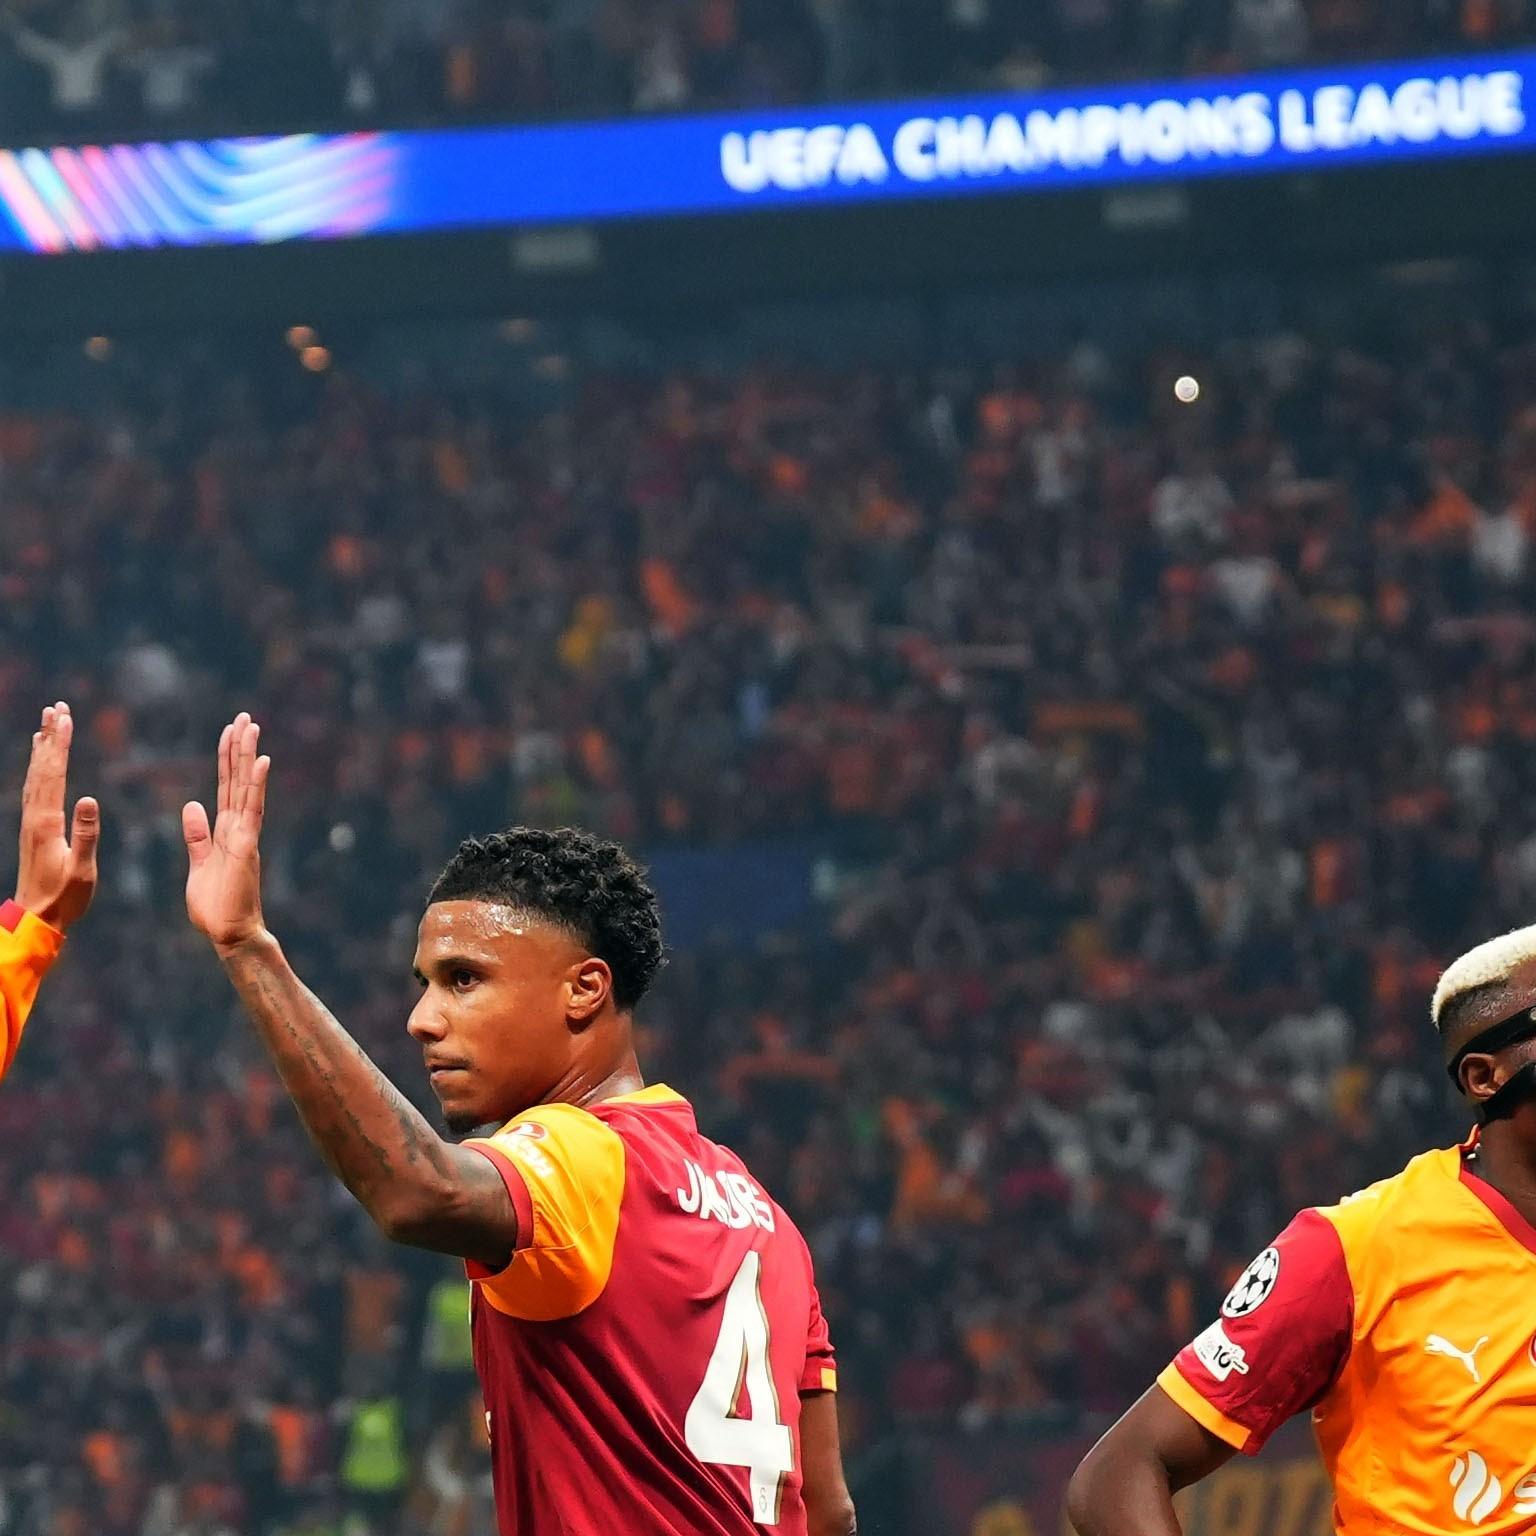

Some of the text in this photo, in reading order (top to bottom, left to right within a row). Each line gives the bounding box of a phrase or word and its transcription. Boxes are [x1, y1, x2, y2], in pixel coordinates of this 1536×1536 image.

[720, 70, 1526, 194] UEFA CHAMPIONS LEAGUE
[684, 1249, 795, 1526] 4
